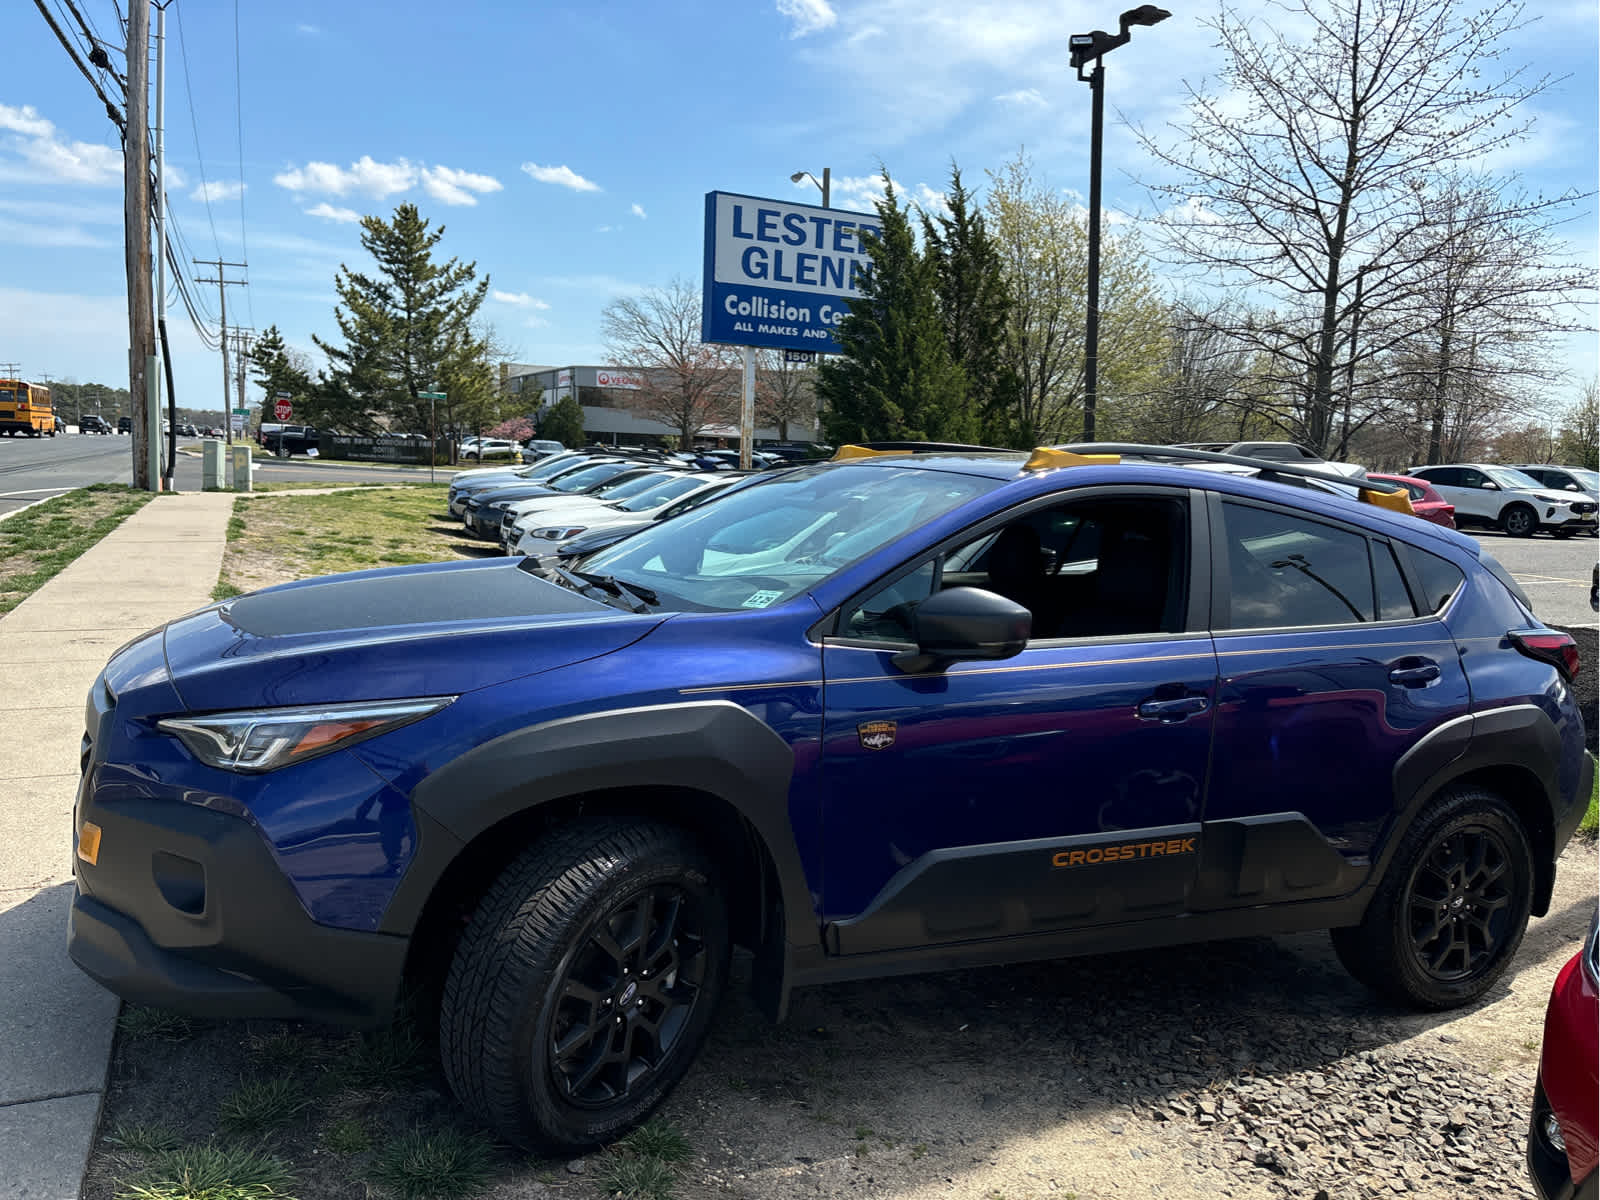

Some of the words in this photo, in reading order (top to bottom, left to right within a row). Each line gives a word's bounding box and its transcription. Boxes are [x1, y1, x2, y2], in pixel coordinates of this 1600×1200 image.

[741, 246, 873, 291] GLENN
[725, 294, 810, 323] Collision
[734, 322, 754, 332] ALL
[758, 324, 798, 337] MAKES
[803, 328, 827, 339] AND
[787, 351, 815, 363] 1501
[274, 404, 293, 415] STOP
[1052, 837, 1196, 867] CROSSTREK
